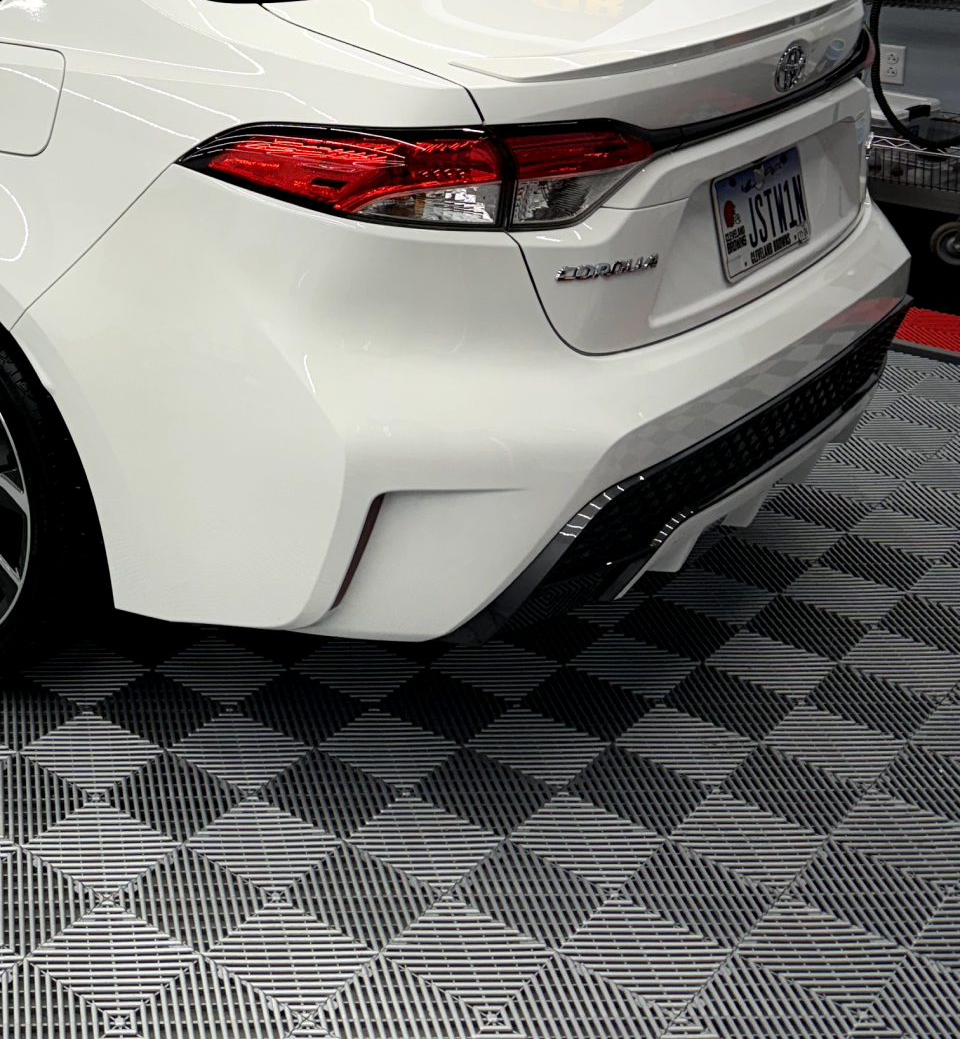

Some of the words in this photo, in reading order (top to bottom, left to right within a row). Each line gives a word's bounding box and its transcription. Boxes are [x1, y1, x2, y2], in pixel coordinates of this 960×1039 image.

[748, 174, 807, 248] JSTW1N
[725, 225, 746, 242] CLEVELAND
[727, 234, 747, 255] BROWNS
[750, 242, 773, 264] CLEVELAND
[772, 233, 791, 252] BROWNS
[555, 253, 659, 282] COROLLA
